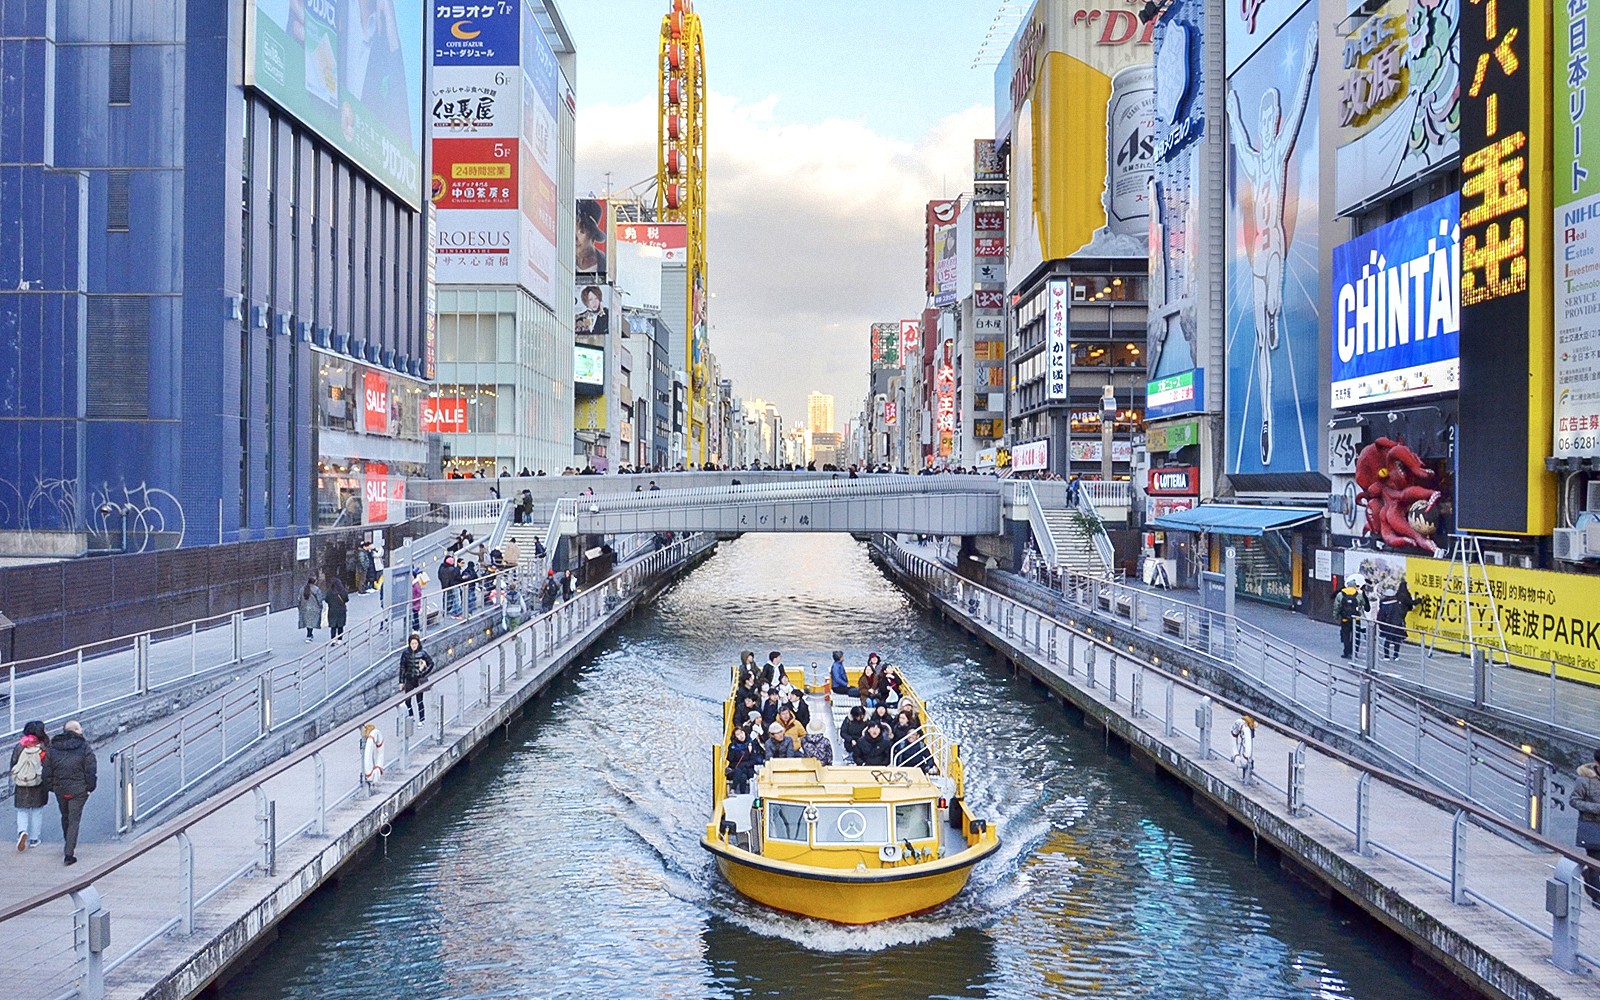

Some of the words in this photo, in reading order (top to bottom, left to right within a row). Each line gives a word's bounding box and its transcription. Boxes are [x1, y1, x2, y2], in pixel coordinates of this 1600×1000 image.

[436, 5, 495, 18] カラオケ
[497, 1, 513, 15] 7F
[436, 49, 495, 57] コート・ダジュール
[494, 71, 511, 86] 6F
[433, 96, 495, 120] 但馬屋
[449, 117, 478, 132] DX
[494, 143, 511, 157] 5F
[1564, 227, 1587, 244] Real
[1565, 244, 1595, 261] Estate
[1564, 292, 1597, 308] SERVICE
[366, 390, 386, 413] SALE
[423, 409, 464, 423] SALE
[1559, 414, 1600, 432] 広告主募
[1160, 473, 1187, 488] LOTTERIA
[367, 480, 387, 503] SALE
